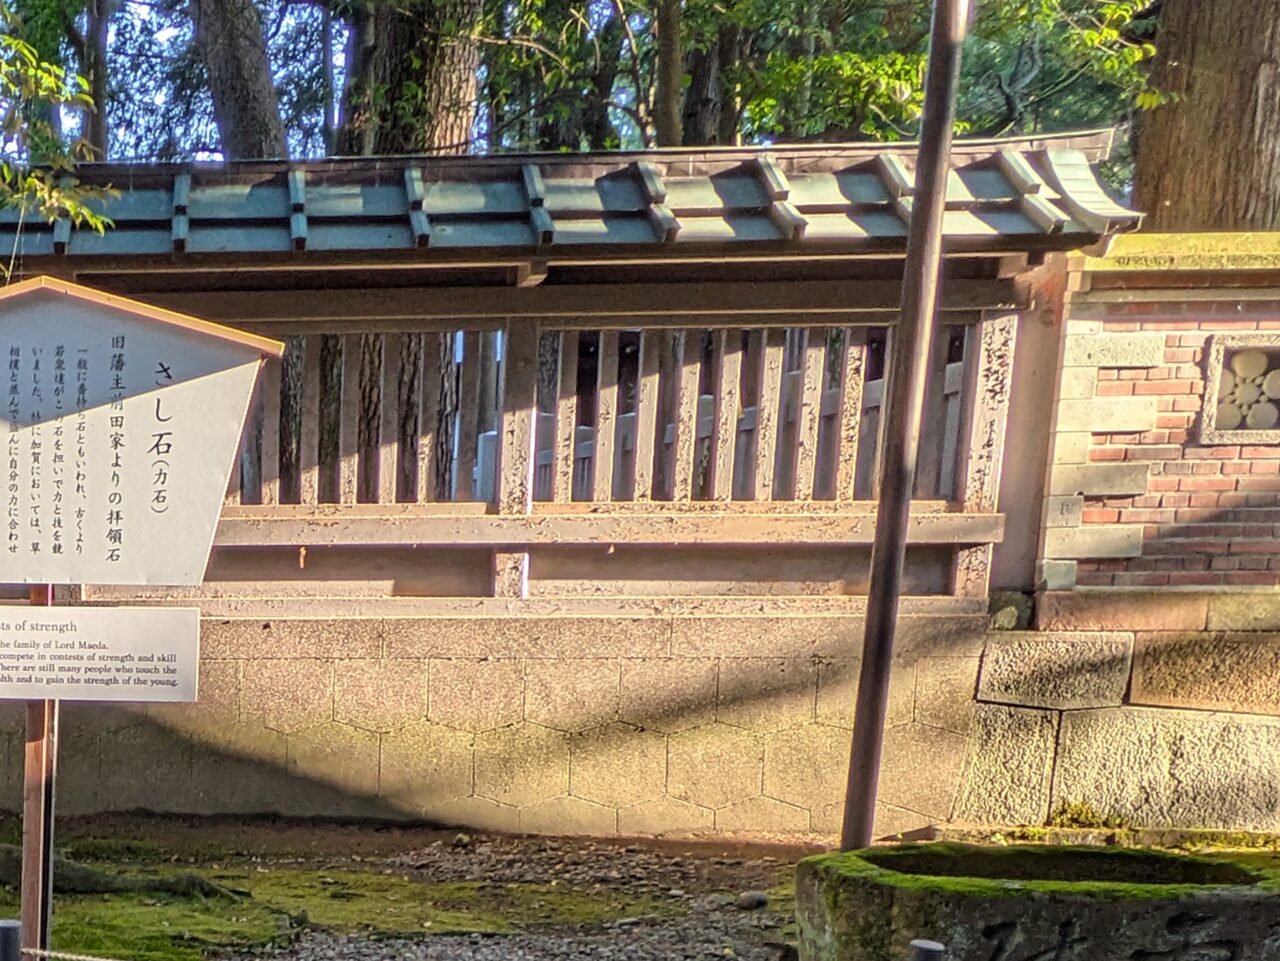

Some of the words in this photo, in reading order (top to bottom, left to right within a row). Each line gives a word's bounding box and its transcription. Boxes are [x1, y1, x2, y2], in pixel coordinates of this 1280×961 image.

[105, 335, 126, 562] 旧藩主前田家よりの拝領石
[15, 620, 27, 631] of
[30, 621, 77, 633] strength
[14, 640, 40, 649] family
[55, 641, 75, 649] Lord
[78, 641, 109, 649] Maeda.
[0, 653, 34, 661] compete
[87, 653, 96, 661] of
[98, 654, 134, 663] strength
[138, 654, 154, 662] and
[157, 654, 176, 662] skill
[39, 663, 55, 672] still
[85, 665, 111, 674] people
[136, 666, 160, 674] touch
[163, 666, 177, 674] the
[46, 677, 64, 685] gain
[67, 676, 81, 684] the
[84, 677, 118, 686] strength
[122, 677, 131, 685] of
[134, 677, 147, 685] the
